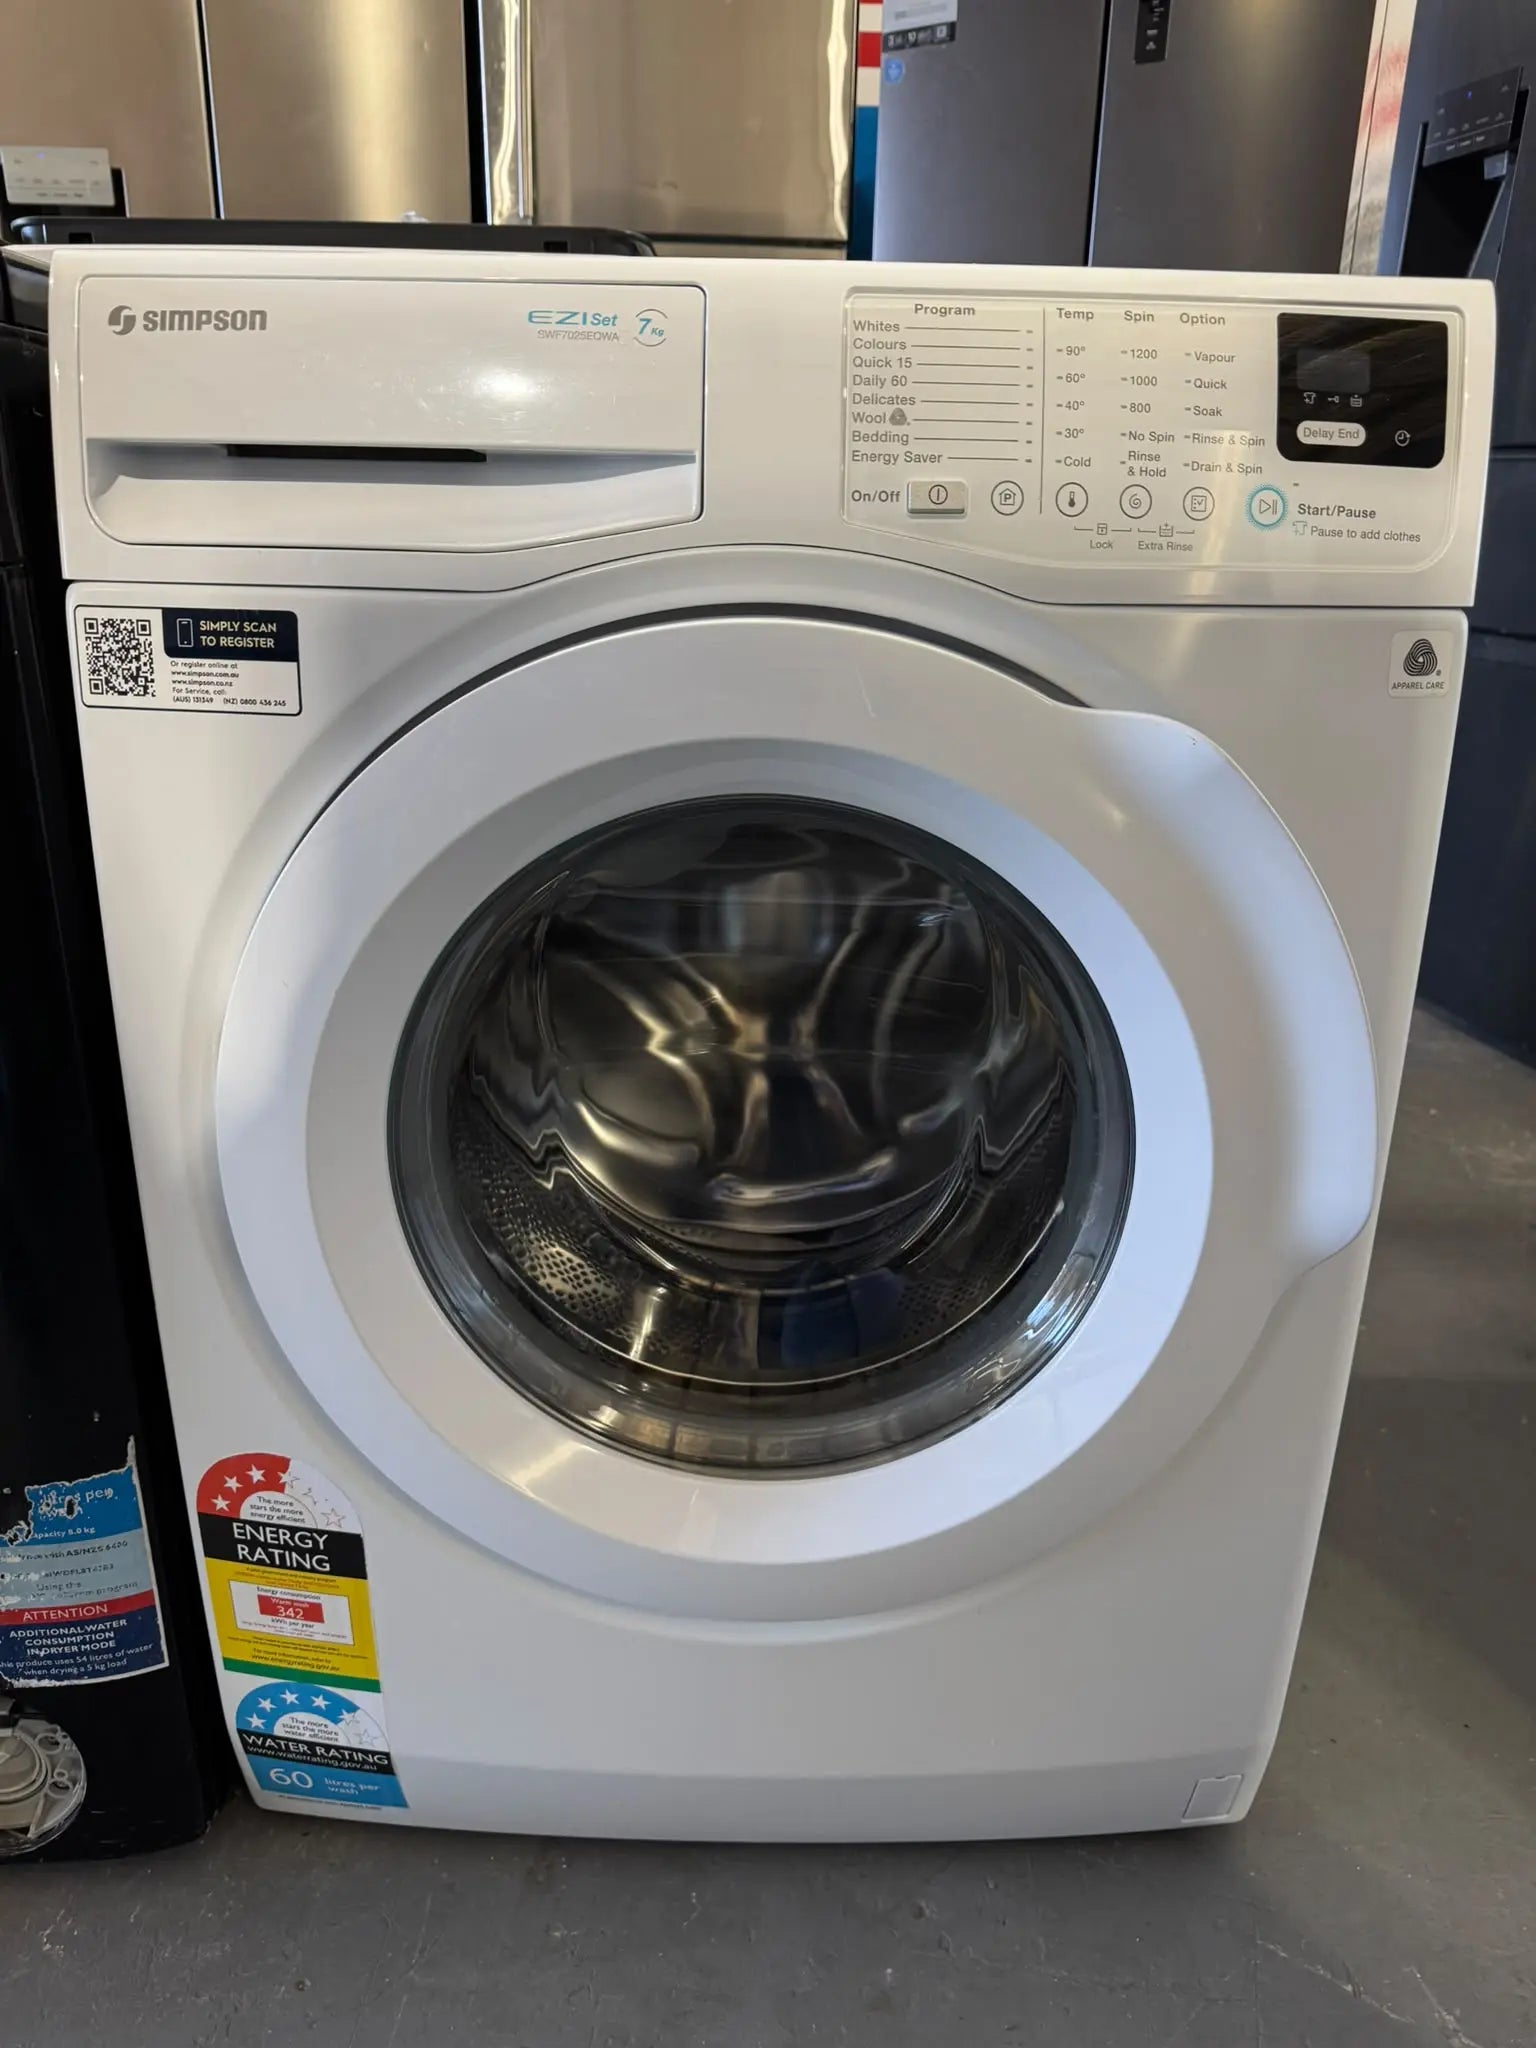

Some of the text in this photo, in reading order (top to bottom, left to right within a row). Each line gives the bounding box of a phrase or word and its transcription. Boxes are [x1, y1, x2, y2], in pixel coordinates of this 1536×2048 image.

[914, 303, 976, 317] Program
[1056, 307, 1095, 321] Temp
[1123, 310, 1155, 324] Spin
[142, 309, 268, 332] SIMPSON
[527, 310, 618, 327] EZI Set
[853, 319, 900, 332] Whites
[1179, 312, 1226, 326] Option
[638, 317, 665, 337] 7 Kg
[853, 337, 907, 350] Colours
[1130, 348, 1158, 359] 1200
[1194, 351, 1236, 364] Vapour
[852, 355, 912, 369] Quick 15
[852, 374, 908, 389] Daily 60
[1130, 375, 1158, 386] 1000
[1193, 378, 1228, 390] Quick
[852, 392, 917, 406] Delicates
[1129, 402, 1151, 413] 800
[1193, 405, 1223, 417] Soak
[852, 411, 887, 424] Wool
[852, 430, 909, 446] Bedding
[1128, 430, 1175, 445] No Spin
[1192, 433, 1265, 448] Rinse & Spin
[1303, 426, 1360, 441] Delay End
[851, 450, 943, 465] Energy Saver
[1064, 456, 1092, 468] Cold
[1128, 451, 1161, 462] Rinse
[1127, 466, 1166, 478] & Hold
[1191, 461, 1263, 477] Drain & Spin
[851, 489, 901, 503] On/Off
[1297, 503, 1376, 519] Start/Pause
[1310, 526, 1421, 542] Pause to add clothes
[1089, 540, 1113, 550] Lock
[1137, 541, 1194, 552] Extra Rinse
[200, 620, 277, 633] SIMPLY SCAN
[200, 635, 275, 648] TO REGISTER
[181, 662, 206, 670] register
[172, 686, 183, 694] For
[1392, 681, 1445, 690] APPAREL CARE
[257, 1496, 272, 1504] The
[250, 1503, 303, 1516] stars the more
[250, 1511, 306, 1524] energy efficient
[84, 1526, 96, 1535] kg
[232, 1522, 329, 1550] ENERGY
[237, 1543, 330, 1571] RATING
[23, 1603, 108, 1622] ATTENTION
[277, 1605, 305, 1620] 342
[9, 1619, 128, 1638] ADDITIONAL WATER
[25, 1631, 114, 1646] CONSUMPTION
[80, 1640, 116, 1651] MODE
[54, 1658, 74, 1666] uses
[76, 1655, 88, 1663] 54
[89, 1652, 113, 1662] litres
[115, 1649, 126, 1658] of
[127, 1643, 153, 1655] water
[23, 1668, 48, 1676] when
[50, 1665, 78, 1675] drying
[95, 1662, 106, 1671] kg
[107, 1658, 127, 1668] load
[289, 1716, 329, 1728] The more
[282, 1722, 340, 1737] stars the more
[285, 1730, 339, 1743] water efficient
[243, 1733, 388, 1765] WATER RATING
[269, 1768, 313, 1789] 60
[324, 1777, 381, 1794] litres per
[328, 1786, 359, 1796] wash
